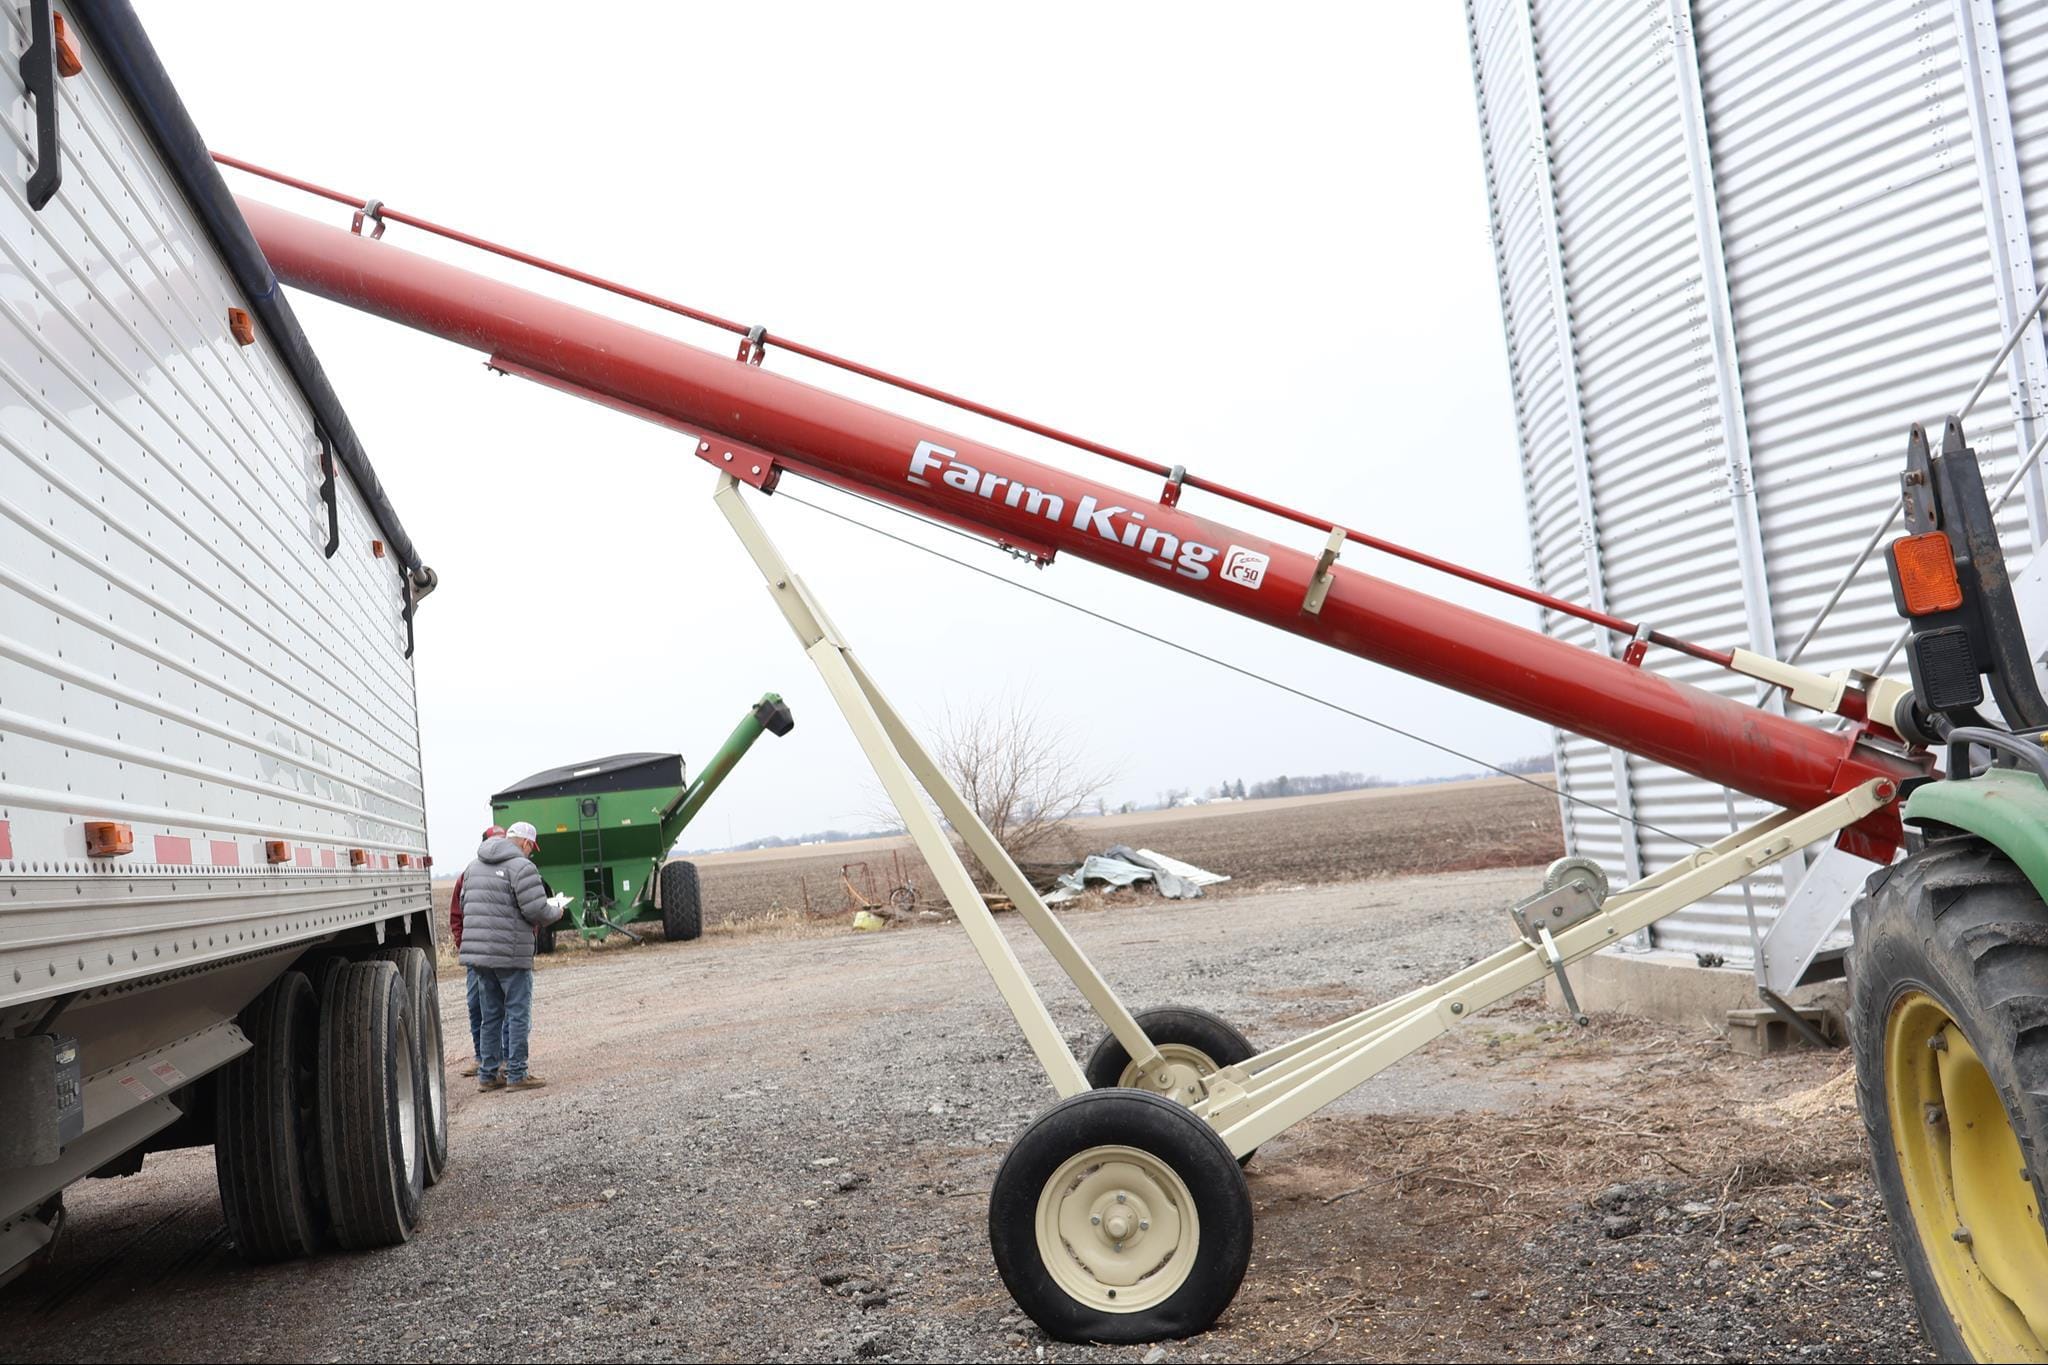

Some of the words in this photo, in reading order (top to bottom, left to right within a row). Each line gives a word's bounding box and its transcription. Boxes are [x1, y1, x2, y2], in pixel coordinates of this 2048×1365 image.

[908, 440, 1064, 522] Farm
[1072, 495, 1219, 580] King
[1243, 567, 1259, 581] 50
